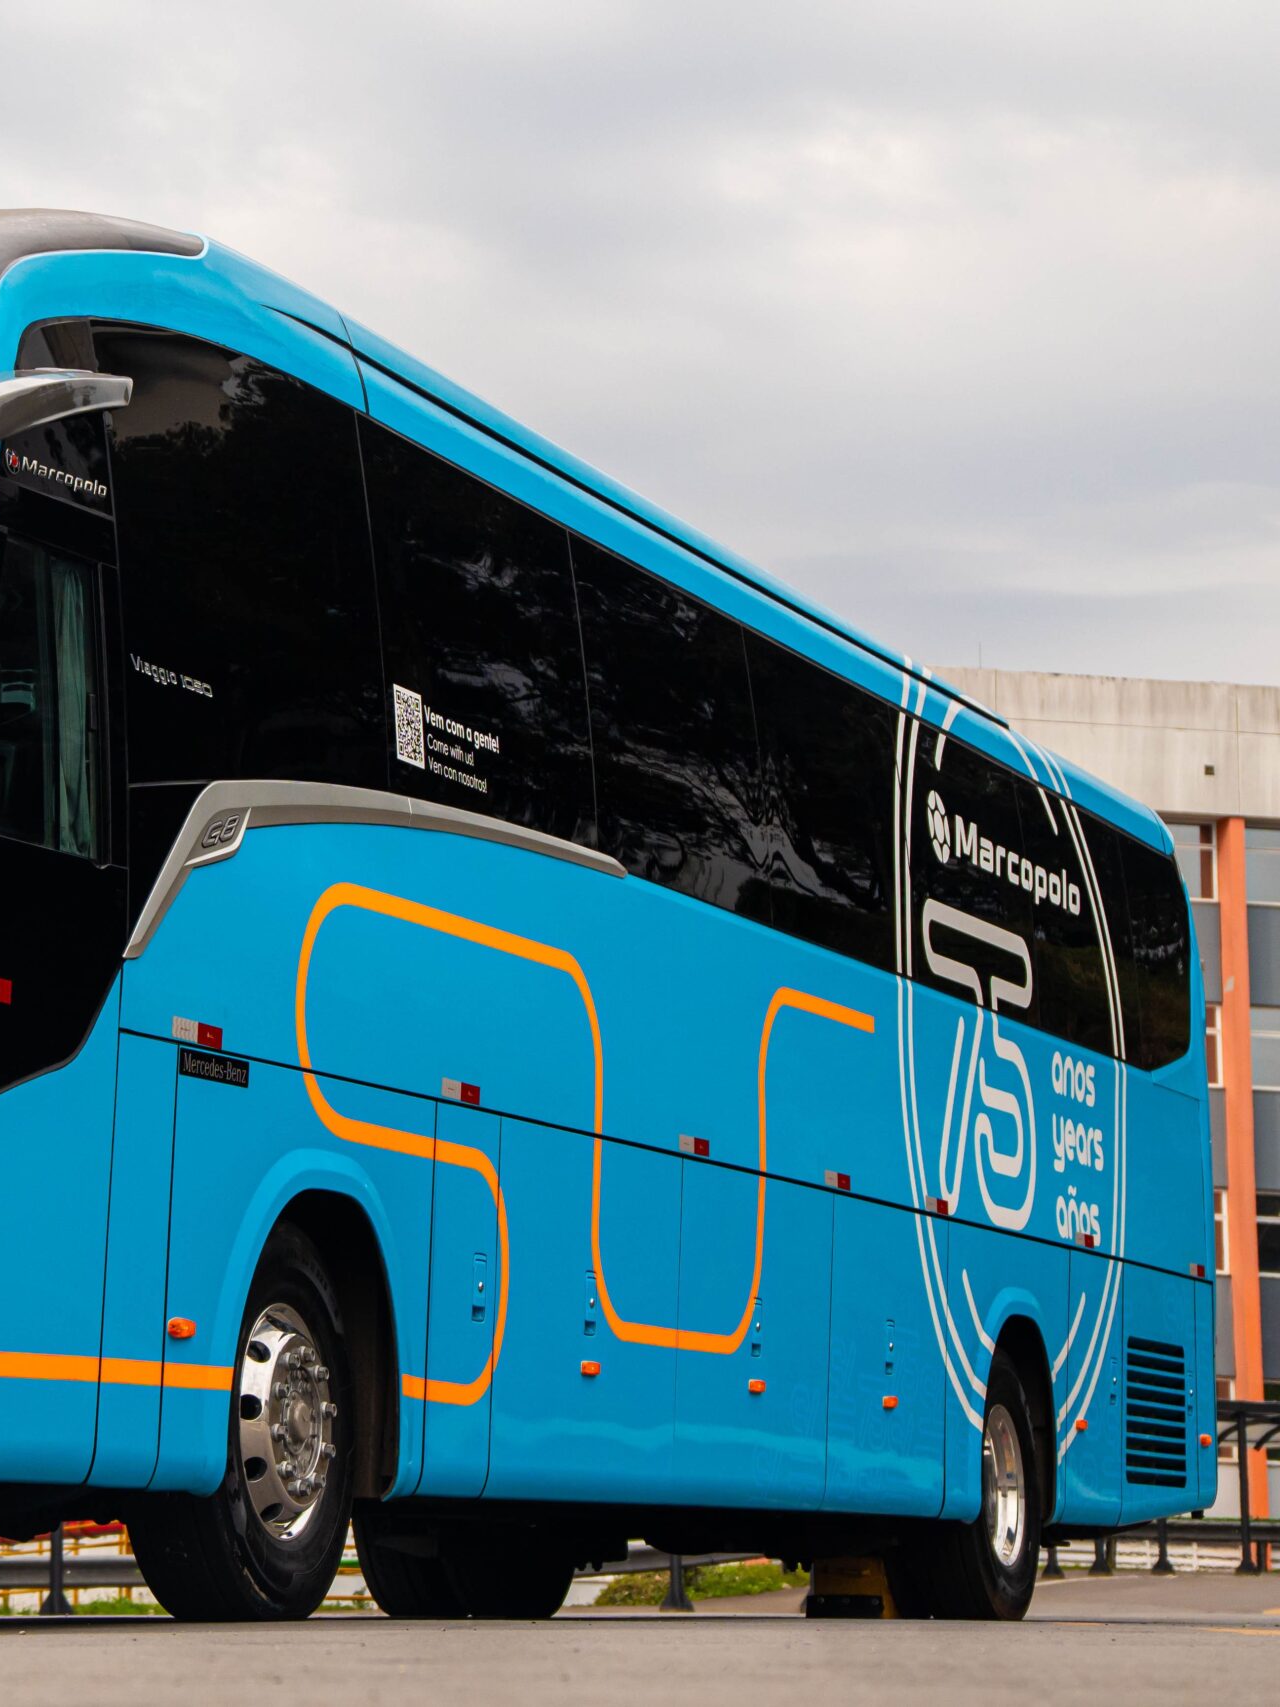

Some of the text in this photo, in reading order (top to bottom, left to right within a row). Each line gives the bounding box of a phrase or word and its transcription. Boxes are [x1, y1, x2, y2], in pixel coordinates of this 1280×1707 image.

[21, 456, 108, 497] Marcopolo
[130, 653, 178, 686] Viaggio
[423, 704, 500, 754] Vem com a gente!
[426, 733, 449, 756] Come
[449, 744, 464, 762] with
[428, 755, 443, 776] Ven
[443, 765, 457, 781] con
[954, 813, 1081, 917] Marcopolo
[183, 1051, 247, 1084] Mercedes-Benz
[922, 898, 1036, 1231] 75
[1051, 1050, 1096, 1108] anos
[1052, 1113, 1104, 1173] years
[1055, 1184, 1102, 1247] años
